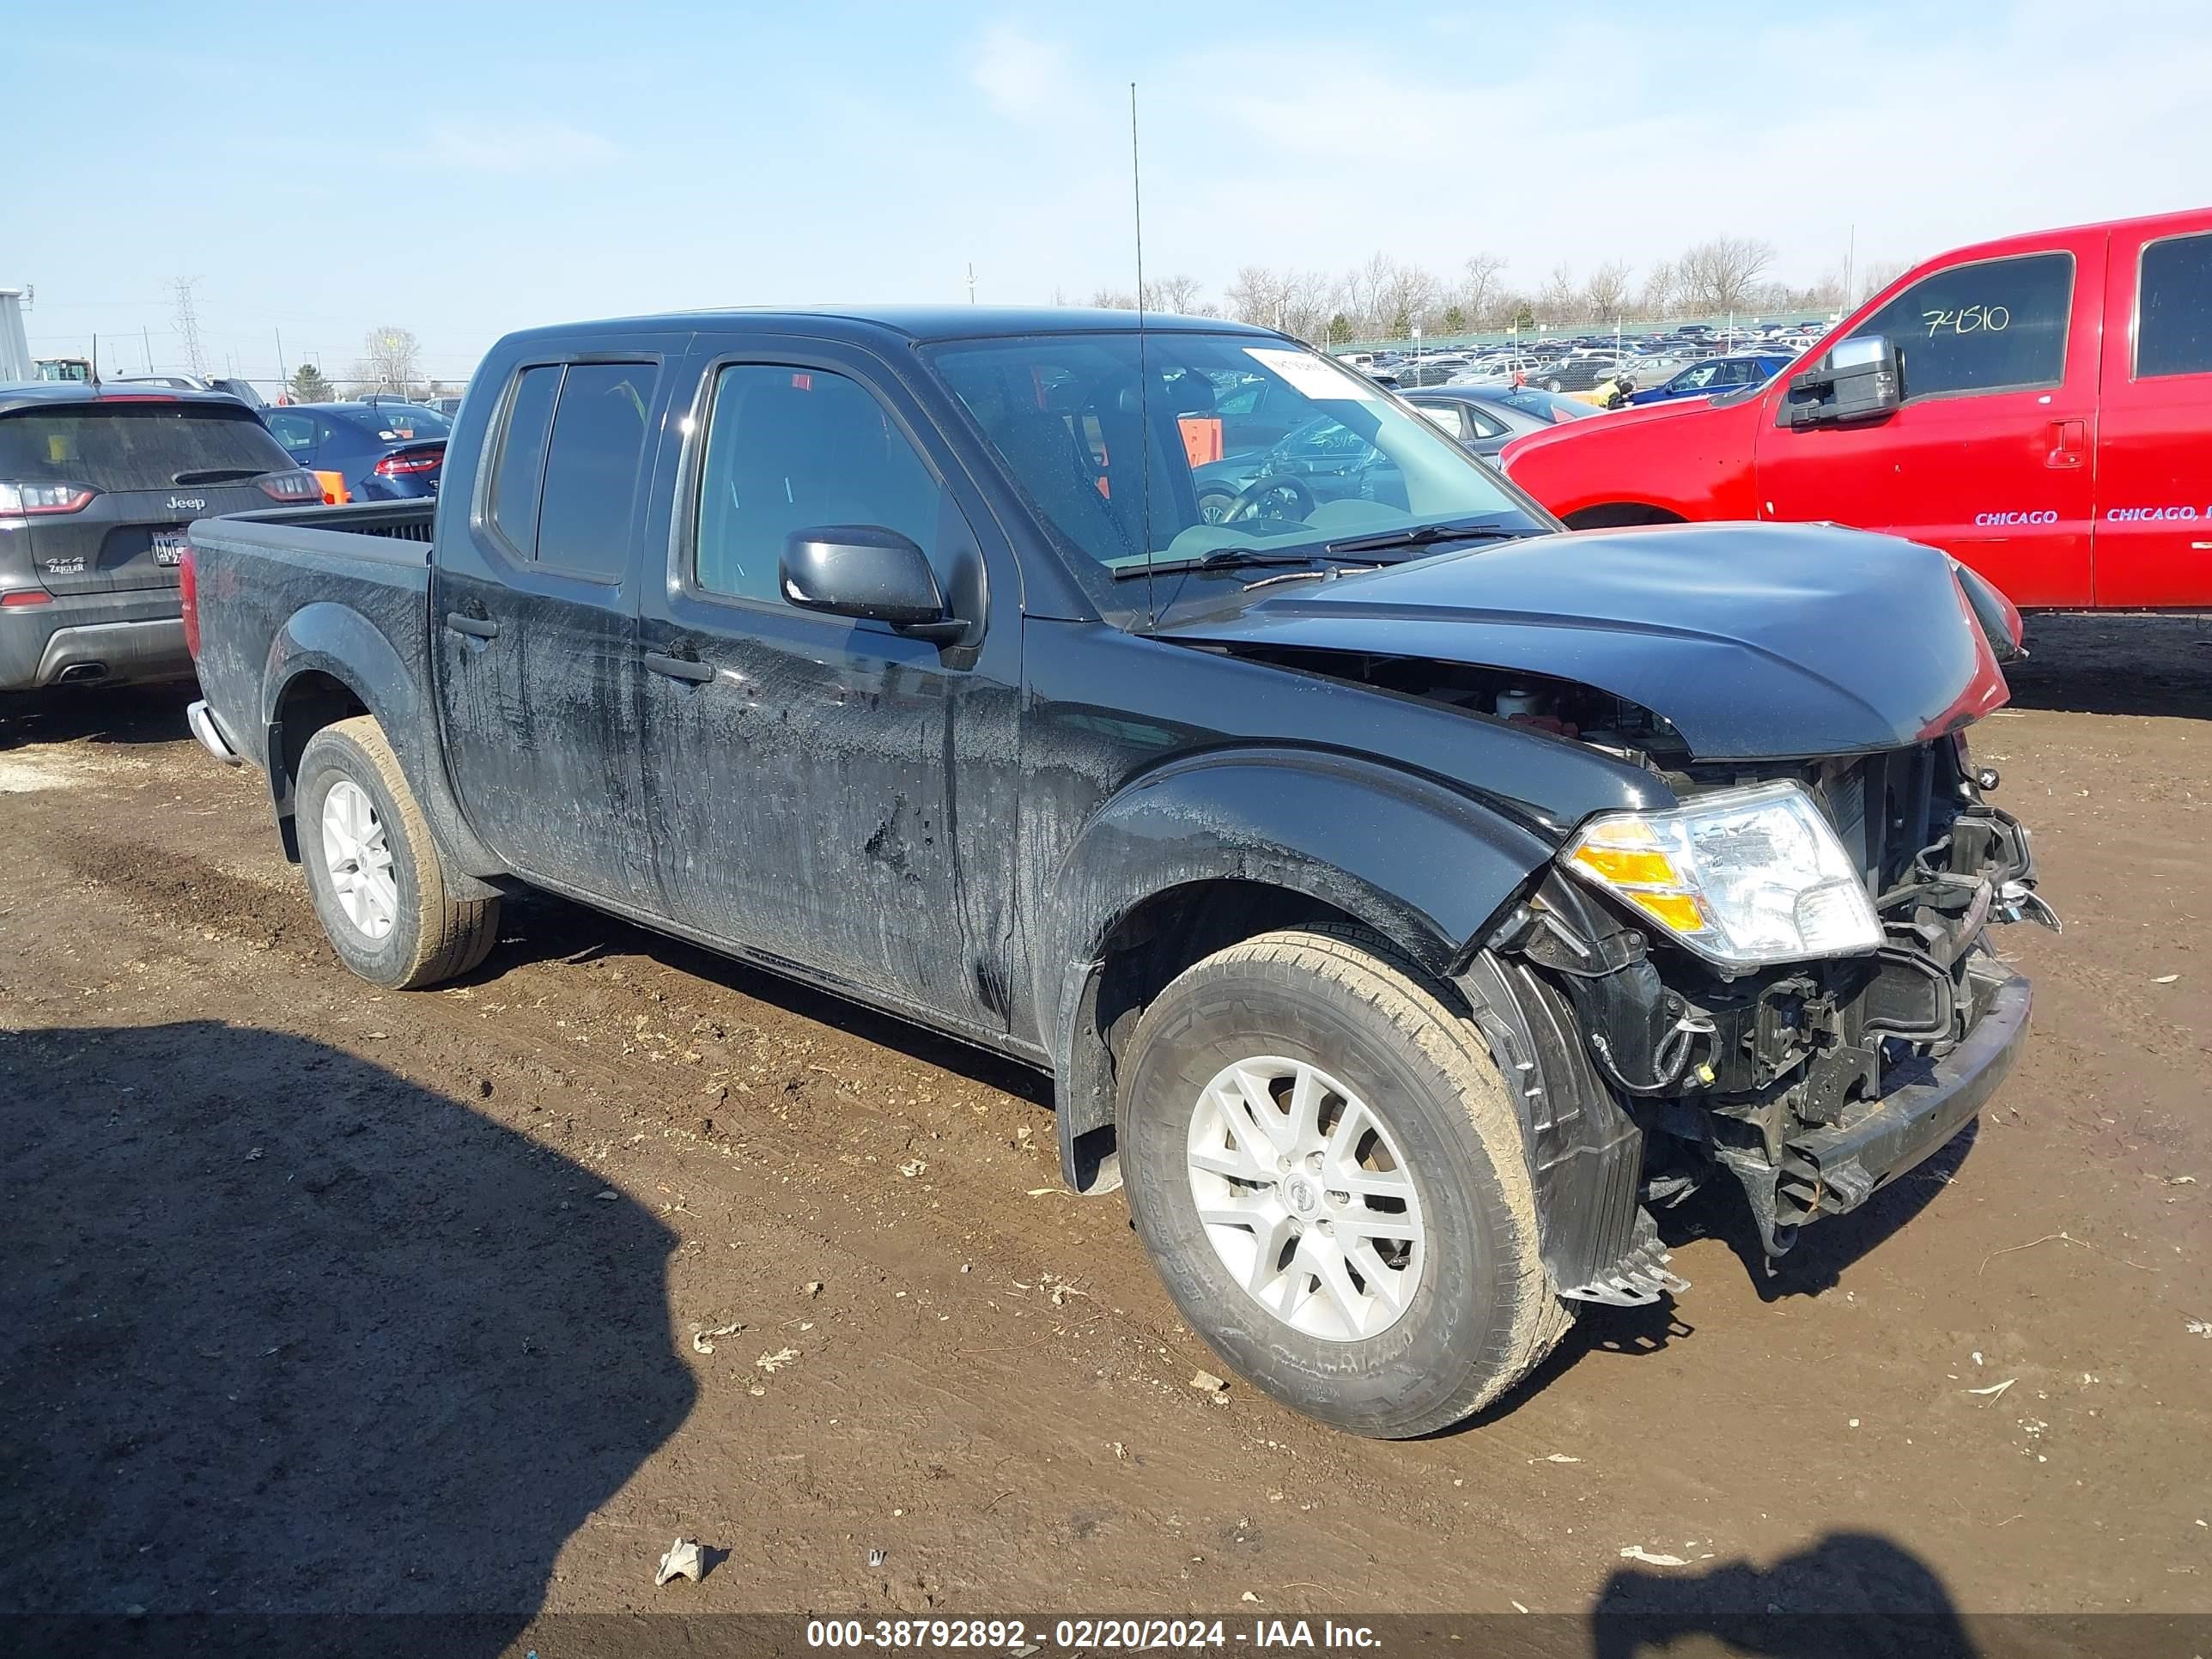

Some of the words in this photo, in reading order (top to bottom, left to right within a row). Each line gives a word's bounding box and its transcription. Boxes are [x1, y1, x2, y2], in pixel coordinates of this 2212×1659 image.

[1923, 305, 2009, 337] 74510
[167, 496, 206, 510] Jeep
[1975, 510, 2058, 526] CHICAGO
[2106, 506, 2199, 522] CHICAGO,
